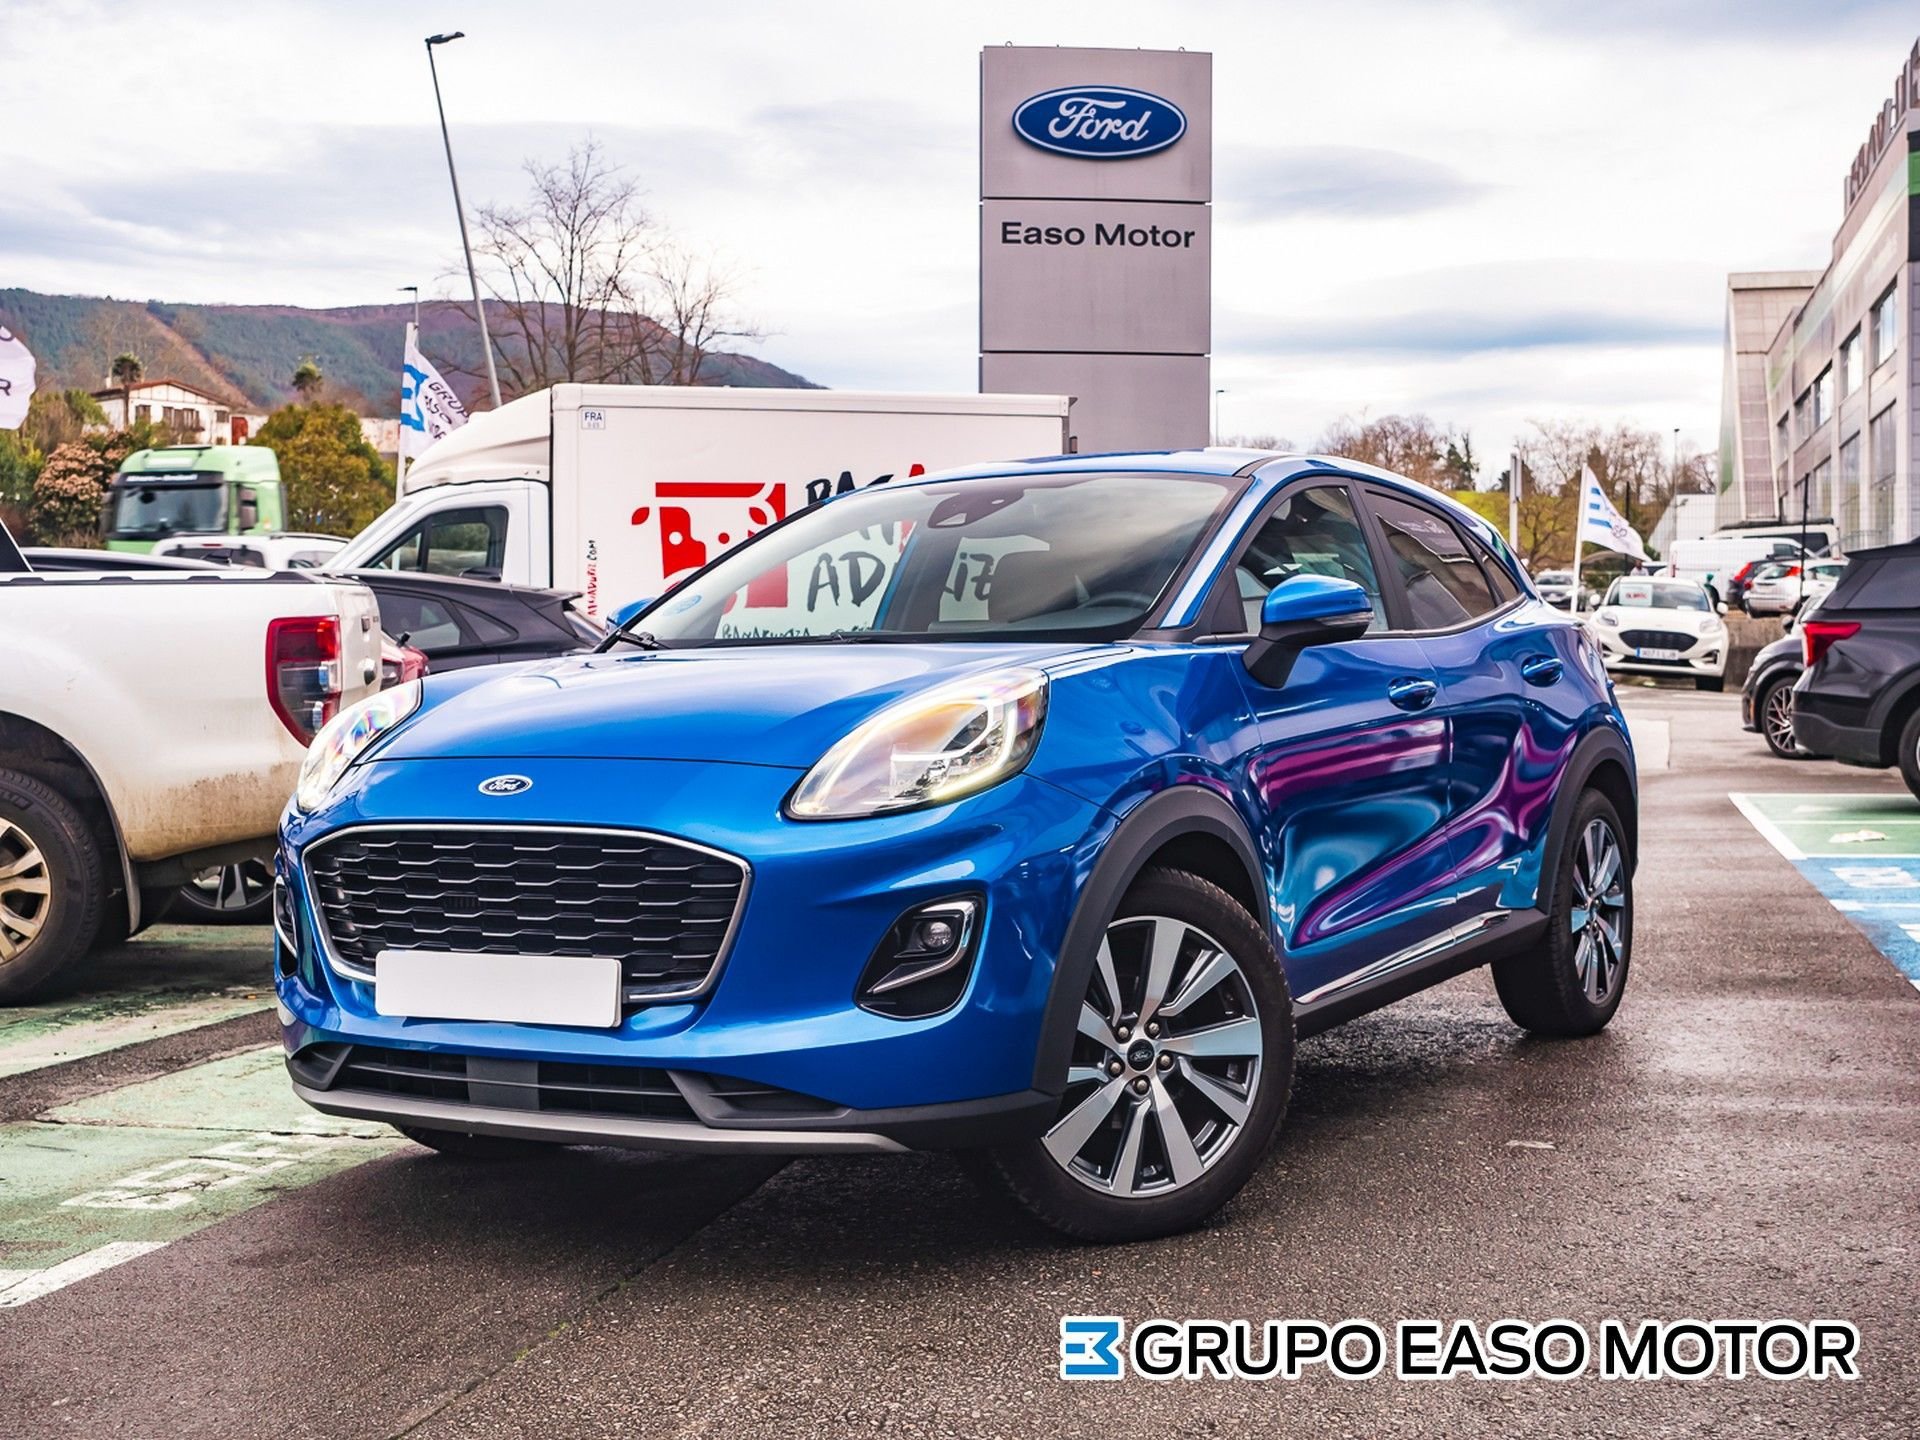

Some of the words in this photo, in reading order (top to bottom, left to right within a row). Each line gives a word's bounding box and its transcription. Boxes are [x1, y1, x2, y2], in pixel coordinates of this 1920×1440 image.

[1048, 96, 1152, 142] Ford
[1000, 221, 1086, 246] Easo
[1095, 222, 1196, 249] Motor
[584, 411, 603, 421] FRA
